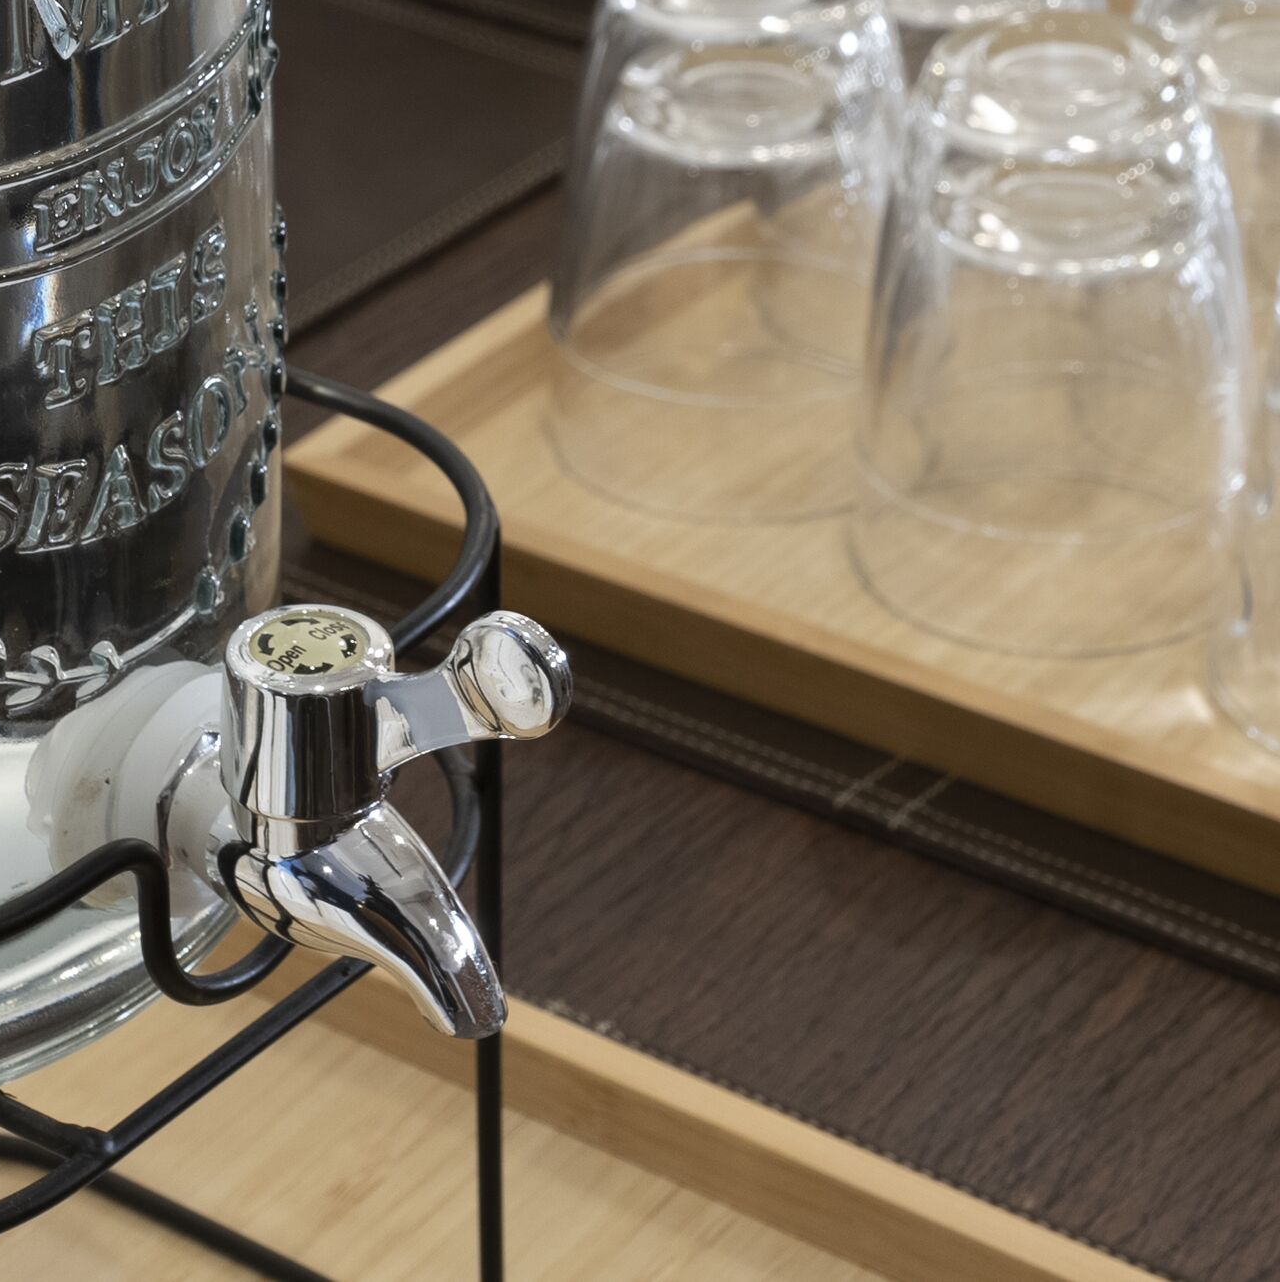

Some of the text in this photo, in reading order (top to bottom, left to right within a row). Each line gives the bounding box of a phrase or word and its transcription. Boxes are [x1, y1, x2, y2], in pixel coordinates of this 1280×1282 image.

[31, 93, 221, 253] ENJOY
[33, 221, 227, 411] THIS
[266, 644, 308, 673] Open
